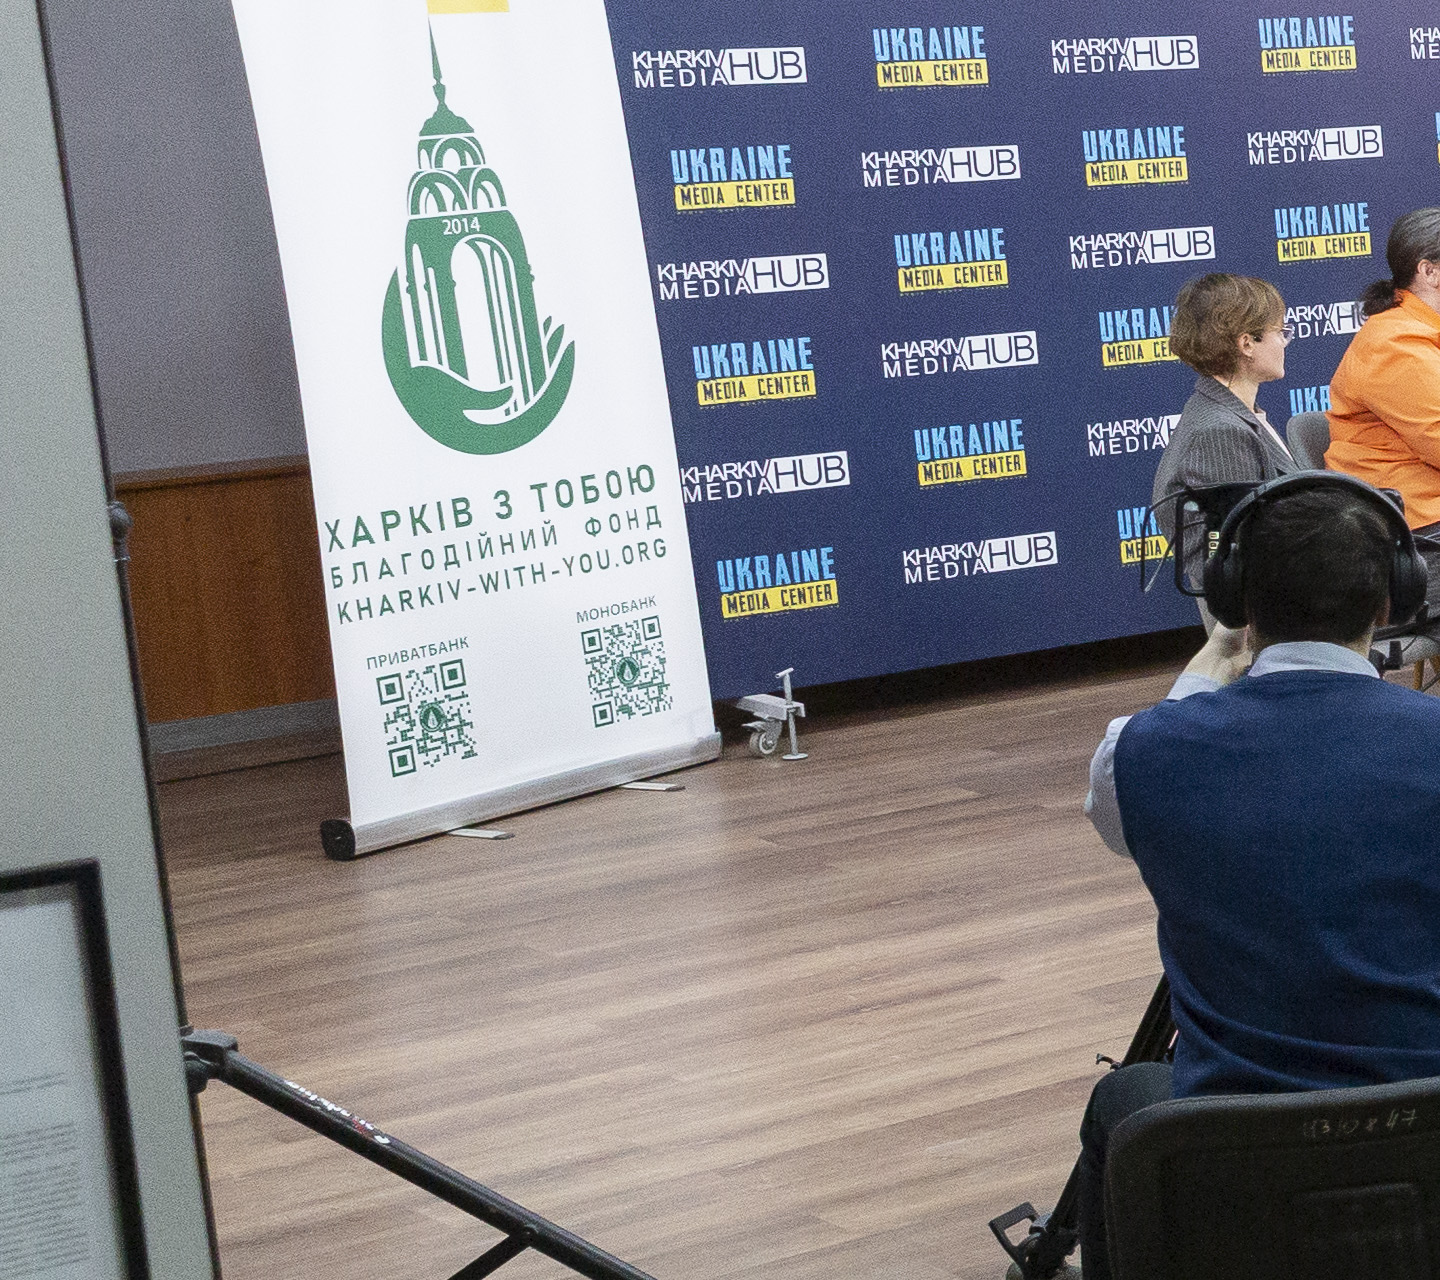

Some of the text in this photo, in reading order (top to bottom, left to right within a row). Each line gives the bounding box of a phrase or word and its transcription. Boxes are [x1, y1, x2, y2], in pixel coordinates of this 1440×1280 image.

[871, 25, 987, 62] UKRAINE
[1051, 37, 1133, 56] KHARKIV
[1257, 15, 1355, 49] UKRAINE
[631, 49, 728, 70] KHARKIV
[634, 51, 804, 89] MEDIA HUB
[881, 61, 985, 83] MEDIA CENTER
[1052, 39, 1196, 74] MEDIA HUB
[1265, 49, 1353, 68] MEDIA CENTER
[443, 217, 480, 235] 2014
[893, 227, 1007, 268] UKRAINE
[656, 258, 752, 283] KHARKIV
[658, 257, 826, 301] MEDIA HUB
[903, 263, 1004, 288] MEDIA CENTER
[691, 335, 815, 380] UKRAINE
[881, 336, 968, 361] KHARKIV
[883, 334, 1036, 378] MEDIA HUB
[702, 373, 812, 401] MEDIA CENTER
[913, 417, 1026, 462] UKRAINE
[680, 458, 774, 486] KHARKIV
[682, 454, 847, 504] MEDIA HUB
[923, 453, 1023, 482] MEDIA CENTER
[324, 464, 656, 553] ХАРКІВ З ТОБОЮ
[332, 505, 662, 589] БЛАГОДІЙНИЙ ФОНД
[903, 539, 989, 567] KHARKIV
[905, 534, 1055, 584] MEDIA HUB
[337, 538, 667, 625] KHARKIV-WITH-YOU.ORG
[716, 545, 837, 594] UKRAINE
[576, 595, 657, 624] МОНОБАНК
[727, 582, 835, 615] MEDIA CENTER
[366, 636, 470, 670] ПРИВАТБАНК
